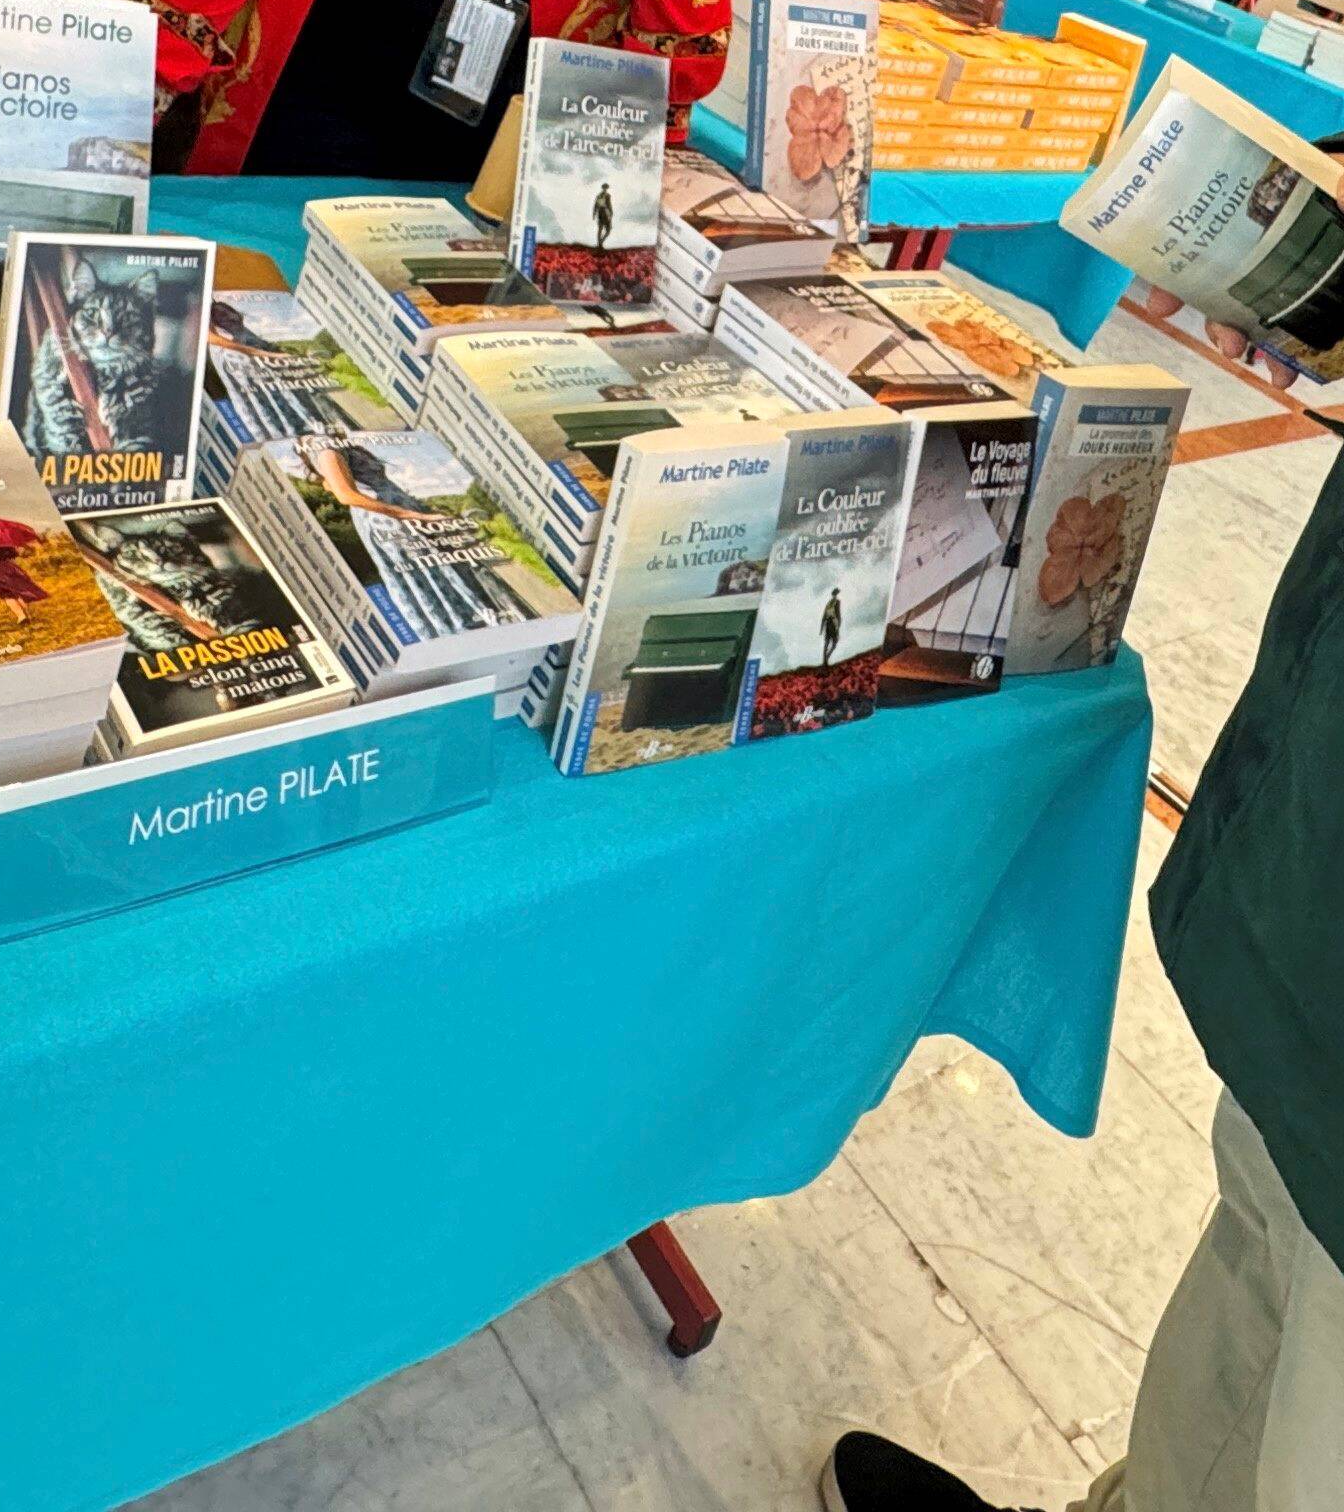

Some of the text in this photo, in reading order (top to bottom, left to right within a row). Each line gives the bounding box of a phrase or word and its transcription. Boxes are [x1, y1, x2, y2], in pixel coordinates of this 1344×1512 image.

[61, 14, 133, 44] Pilate
[794, 37, 860, 52] JOURS HEUREUX
[560, 51, 614, 70] Martine
[561, 95, 648, 123] La Couleur
[1088, 117, 1185, 233] Martine Pilate
[333, 201, 435, 212] Martine Pilate
[1150, 167, 1230, 258] Les Pianos
[1169, 175, 1254, 274] de la victoire
[468, 336, 578, 351] Martine Pilate
[800, 437, 854, 456] Martine
[1089, 428, 1099, 439] La
[970, 440, 1032, 464] Le Voyage
[1078, 442, 1154, 454] JOURS HEUREUX
[41, 454, 57, 486] A
[63, 451, 163, 485] PASSION
[659, 457, 770, 484] Martine Pilate
[971, 463, 1029, 483] du fleuve
[56, 484, 157, 508] selon cinq
[797, 486, 885, 514] La Couleur
[402, 517, 480, 536] Roses
[660, 520, 746, 546] Les Pianos
[415, 542, 512, 568] maquis
[646, 545, 749, 571] de la victoire
[138, 655, 180, 681] LA
[178, 626, 290, 676] PASSION
[188, 662, 247, 689] selon
[249, 653, 299, 672] cinq
[227, 669, 307, 699] matous
[128, 748, 381, 846] Martine PILATE
